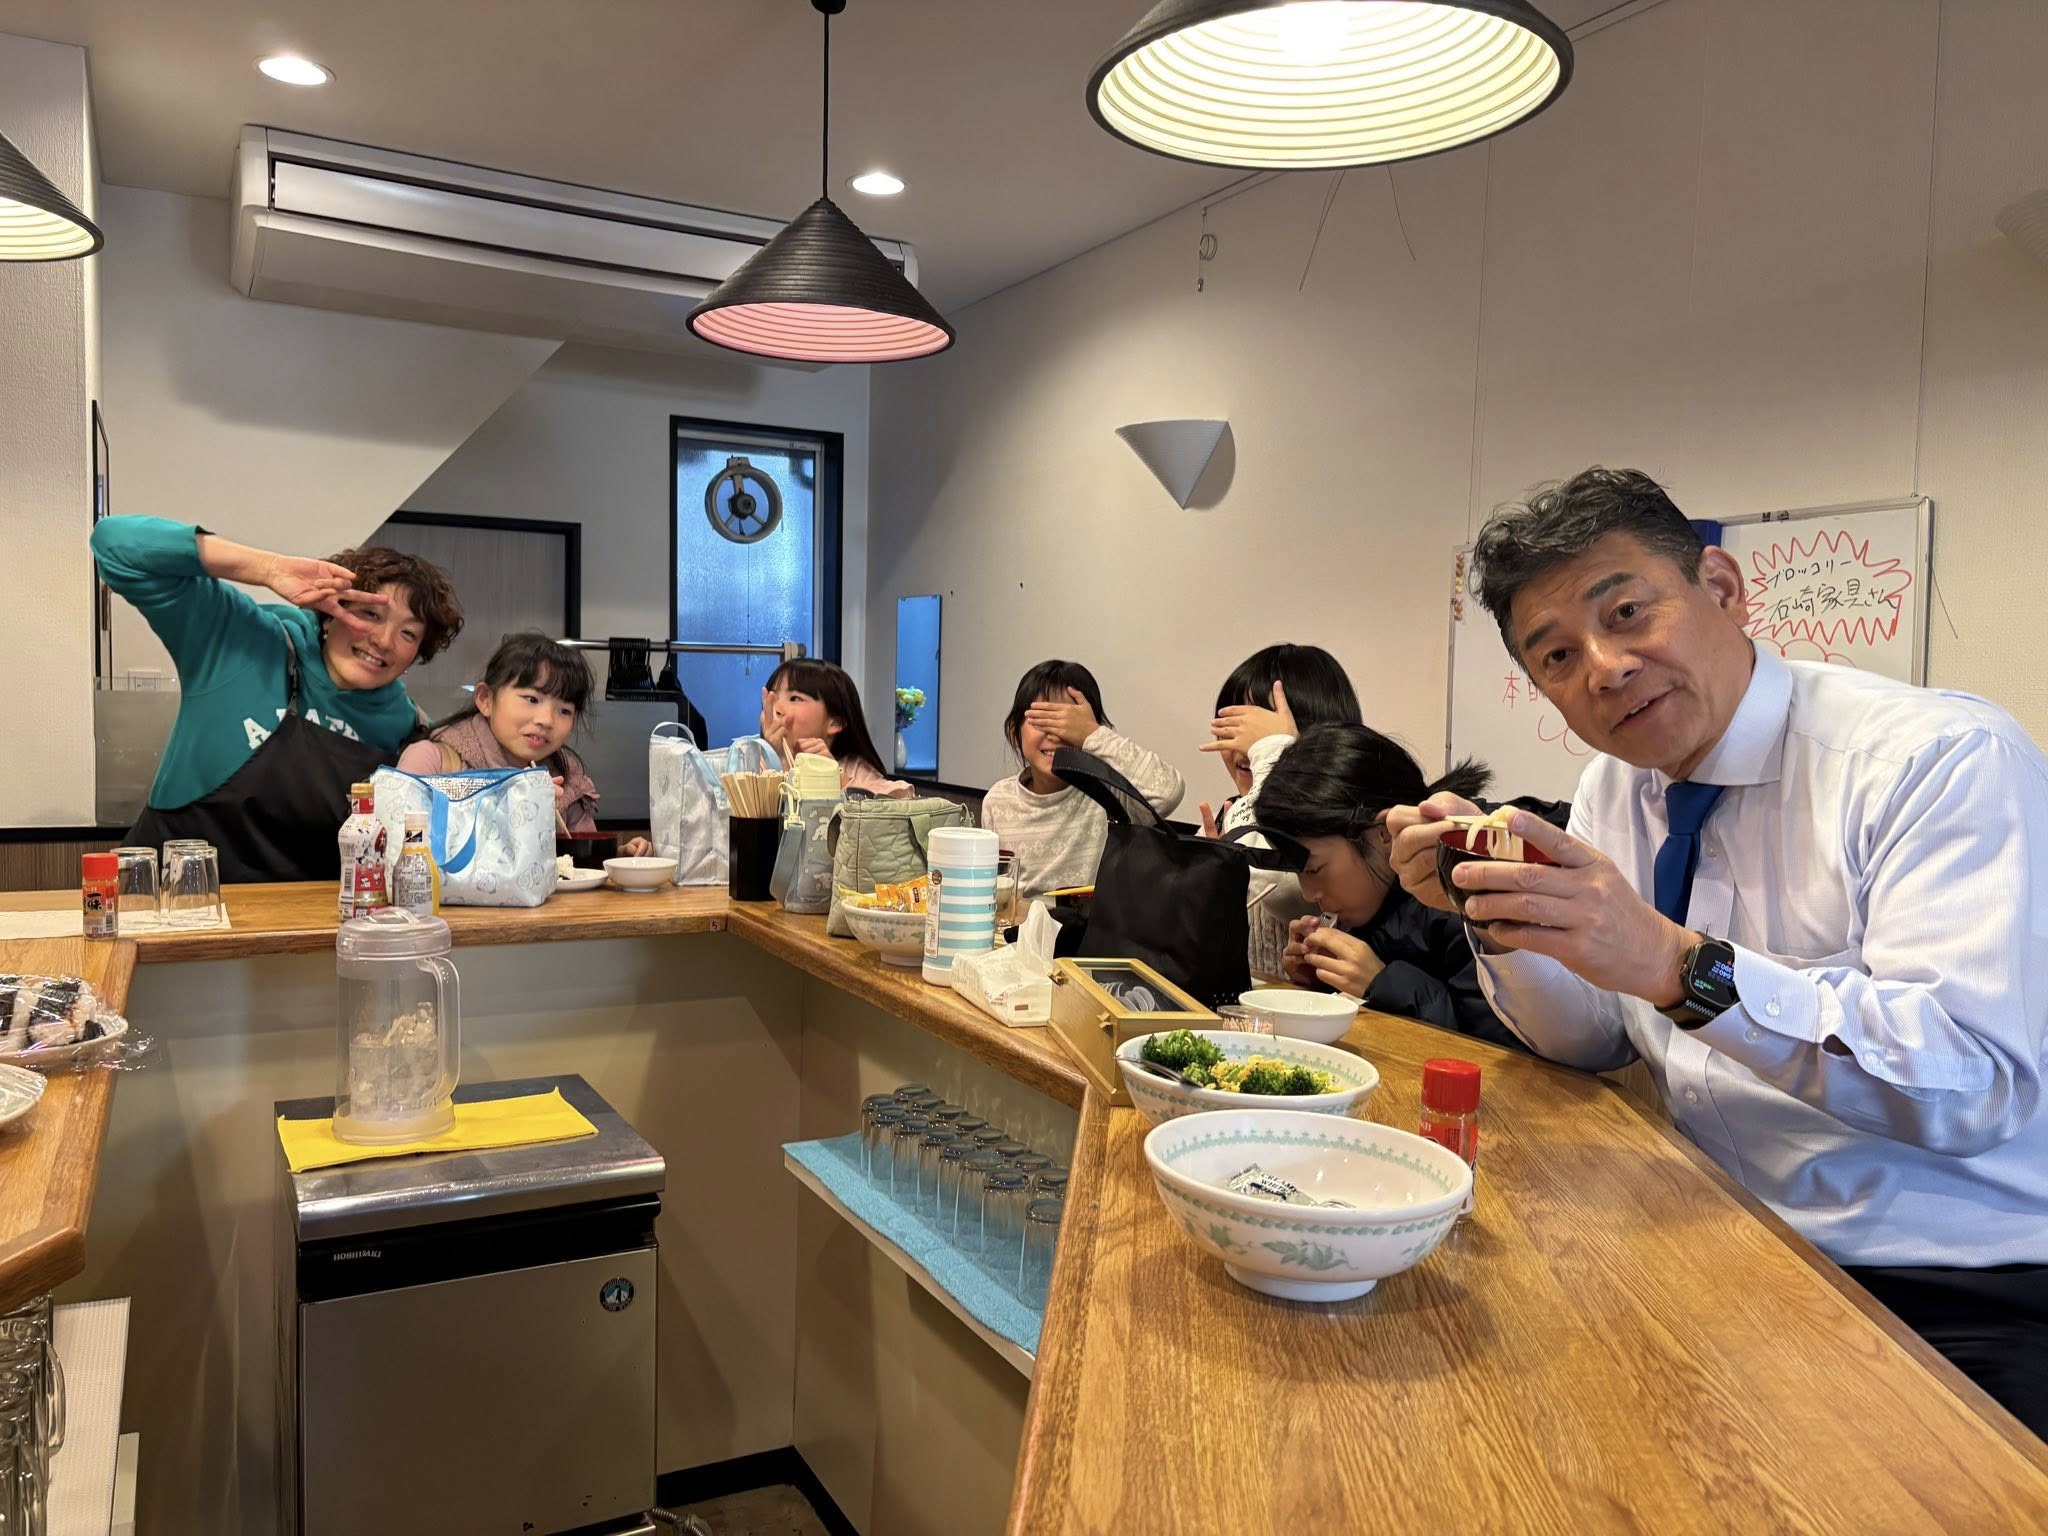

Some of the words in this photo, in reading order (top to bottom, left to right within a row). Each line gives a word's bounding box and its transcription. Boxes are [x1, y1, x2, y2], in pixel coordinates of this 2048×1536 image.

[1766, 559, 1852, 589] ブロッコリー
